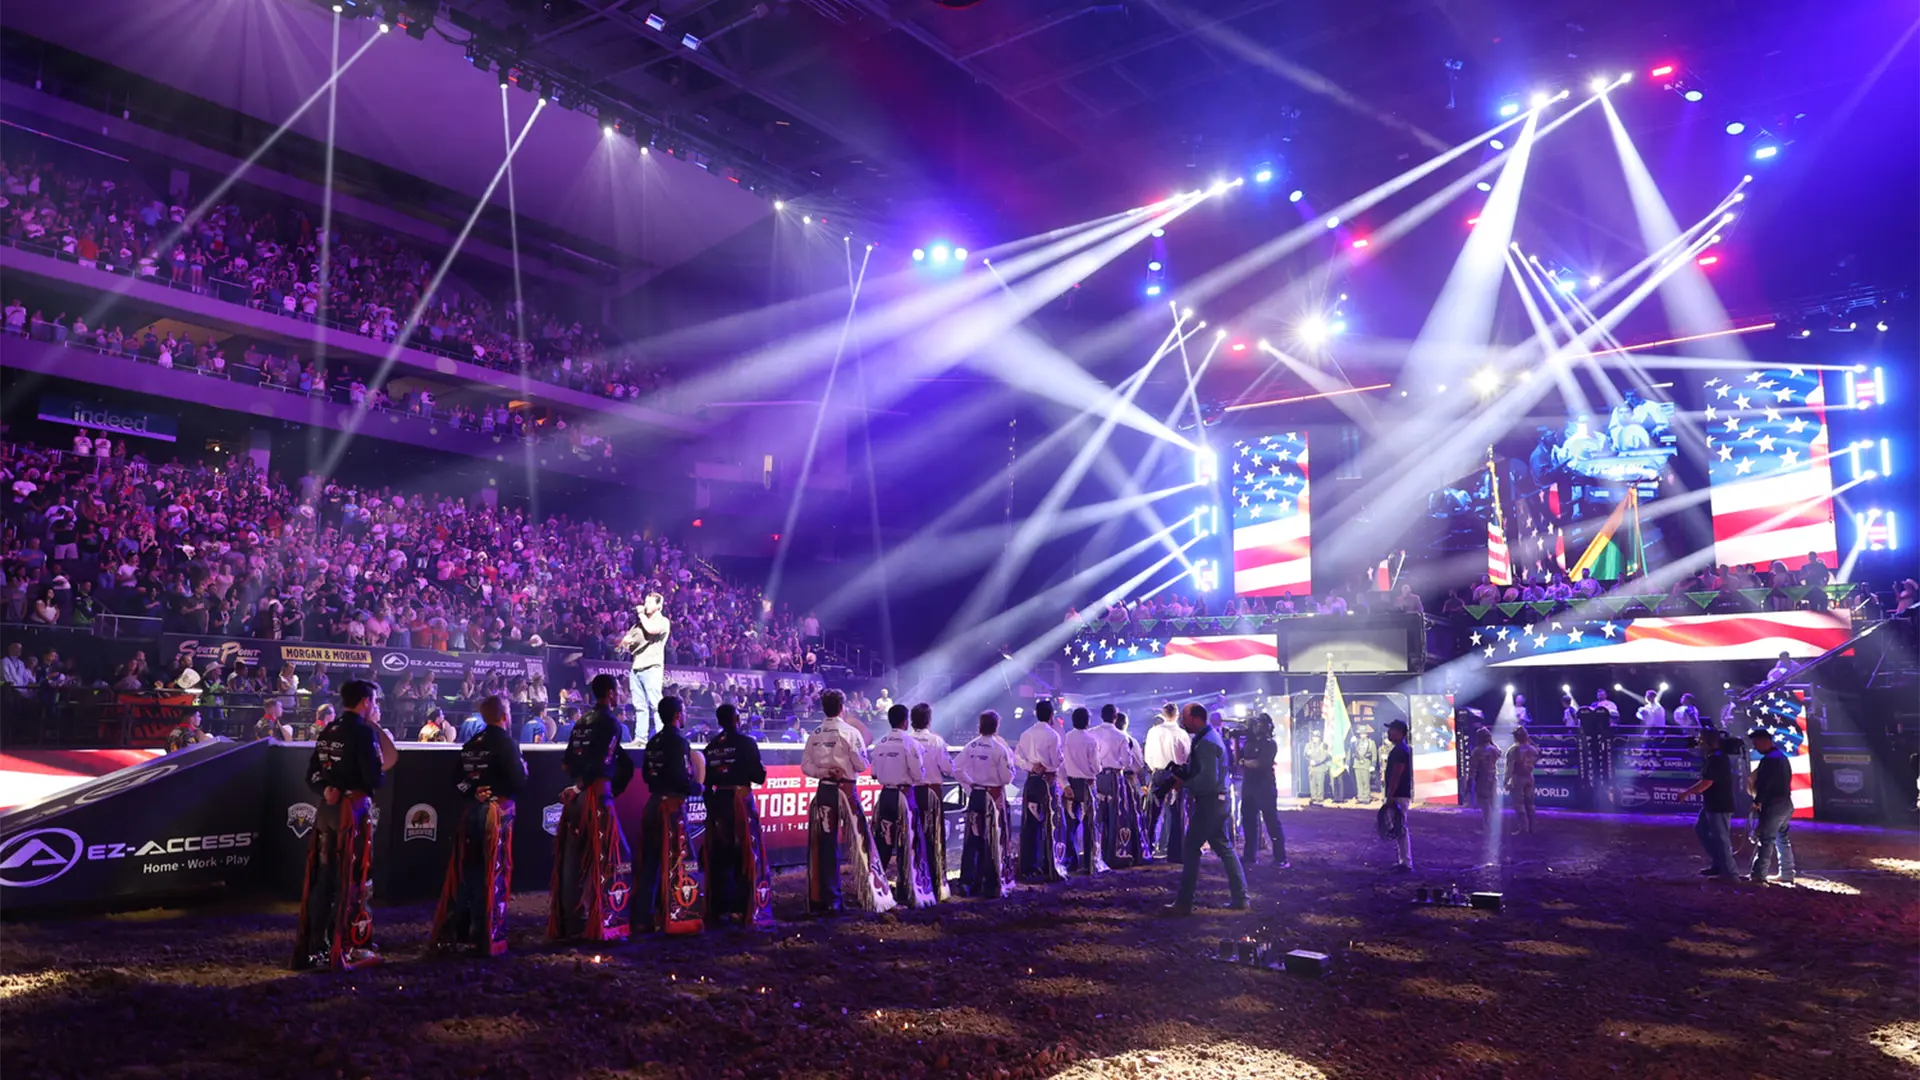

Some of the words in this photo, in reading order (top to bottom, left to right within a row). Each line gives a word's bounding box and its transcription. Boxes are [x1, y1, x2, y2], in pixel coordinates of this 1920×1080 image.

[72, 404, 148, 432] indeed
[175, 640, 220, 661] SOUTH
[220, 641, 261, 664] POINT
[286, 648, 323, 660] MORGAN
[324, 649, 331, 659] &
[332, 650, 368, 661] MORGAN
[474, 659, 501, 668] RAMPS
[502, 661, 520, 669] THAT
[507, 668, 526, 676] EASY
[724, 672, 764, 689] YETI
[767, 777, 801, 789] RIDE
[1534, 787, 1569, 797] WORLD
[1653, 792, 1697, 802] OCTOER
[754, 791, 815, 818] TOBE
[87, 832, 253, 860] EZ-ACCESS
[143, 863, 178, 874] Home
[188, 858, 217, 870] Work
[226, 855, 250, 867] Play
